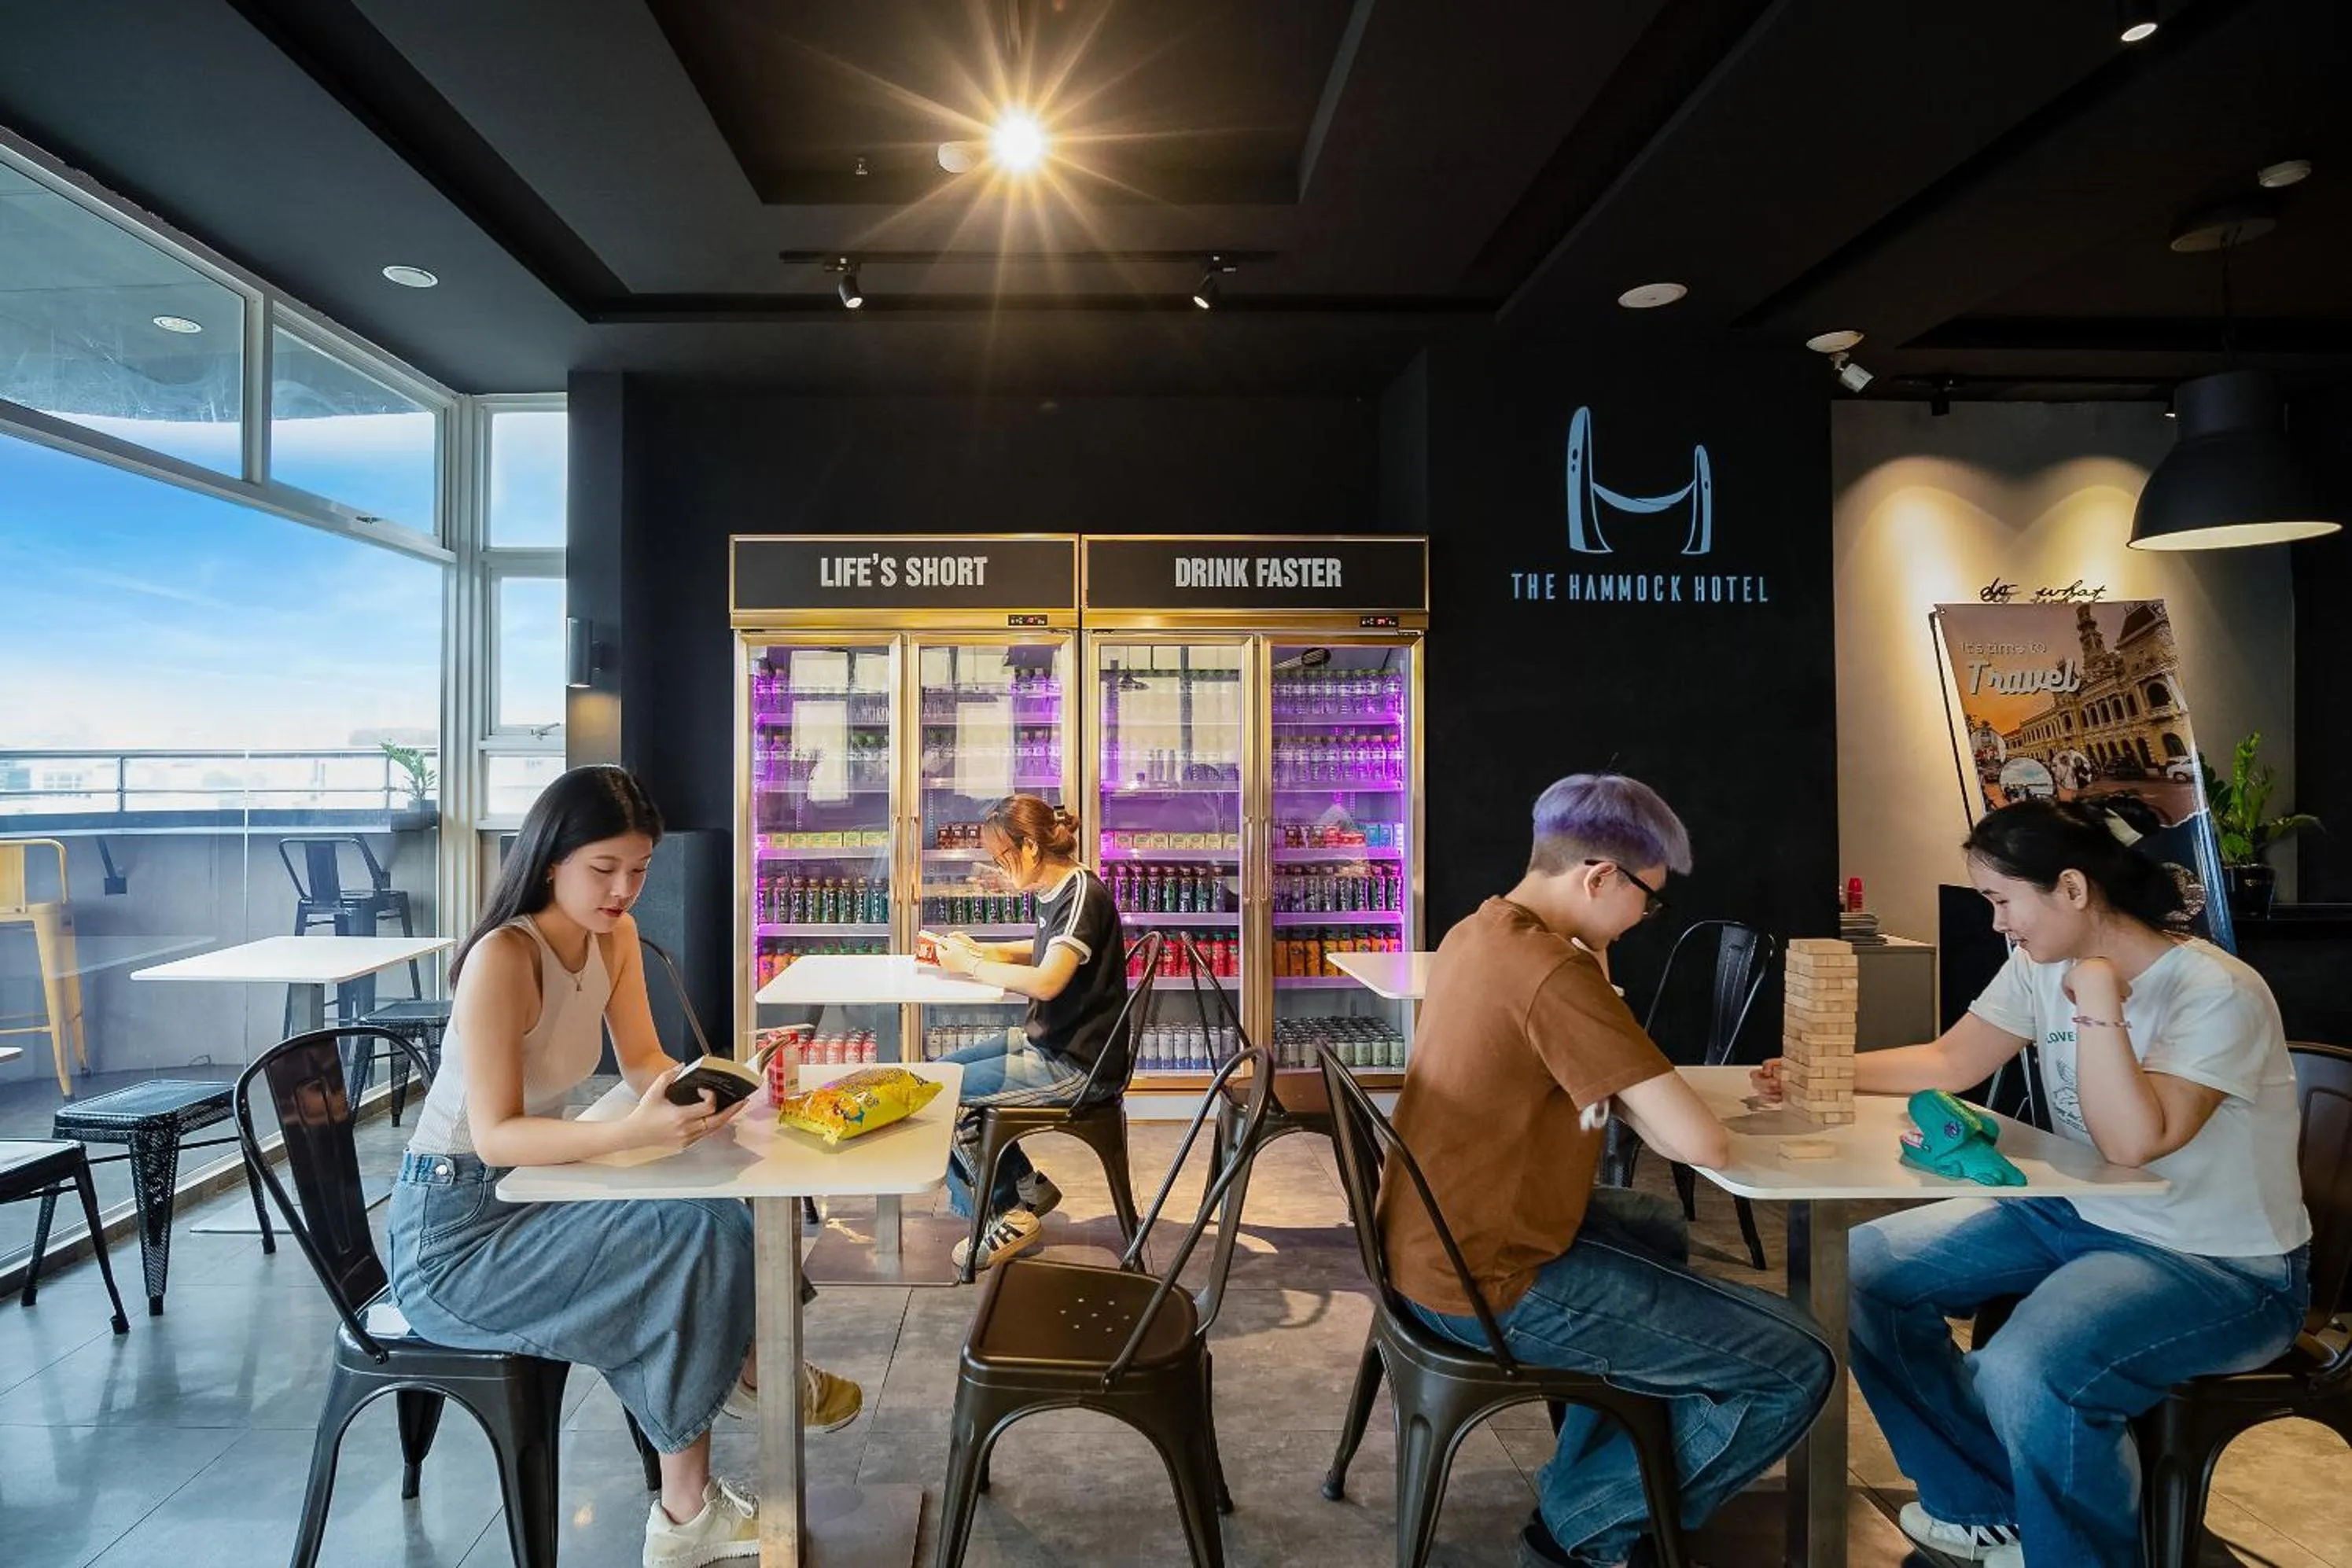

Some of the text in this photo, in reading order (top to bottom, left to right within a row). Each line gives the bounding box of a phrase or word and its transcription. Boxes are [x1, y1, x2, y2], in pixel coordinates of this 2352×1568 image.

[820, 554, 988, 587] LIFE'S SHORT
[1175, 558, 1342, 587] DRINK FASTER
[1511, 573, 1769, 602] THE HAMMOCK HOTEL
[2035, 580, 2107, 598] what
[1967, 658, 2081, 696] Travel
